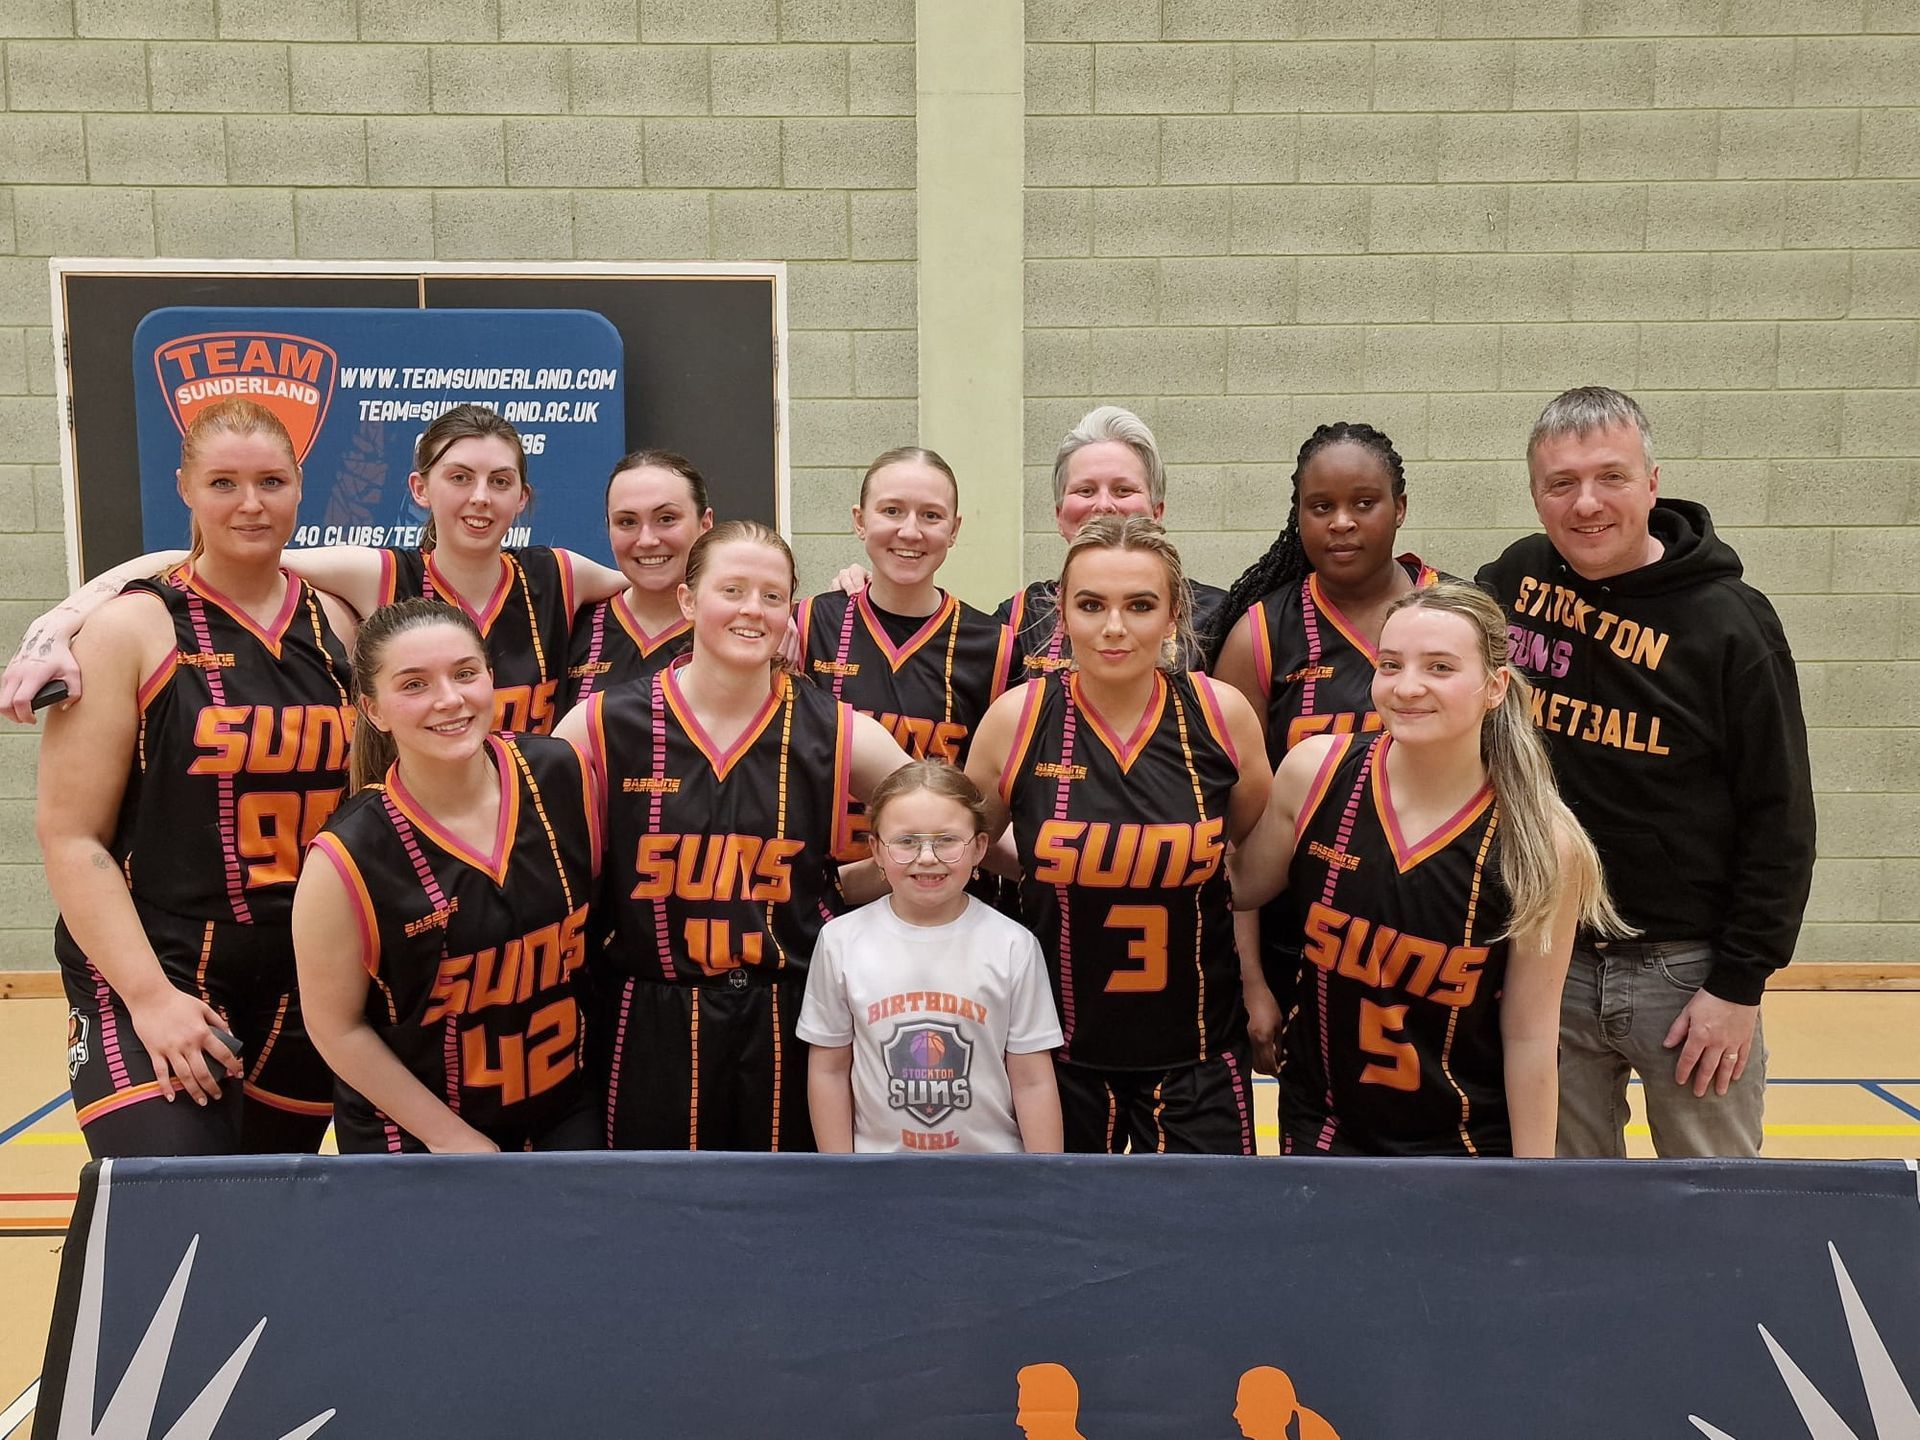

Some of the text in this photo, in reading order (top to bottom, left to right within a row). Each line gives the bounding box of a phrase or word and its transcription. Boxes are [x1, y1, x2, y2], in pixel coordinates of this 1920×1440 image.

[164, 340, 324, 383] TEAM
[340, 367, 617, 391] WWW.TEAMSUNDERLAND.COM
[177, 376, 319, 405] SUNDERLAND
[358, 400, 599, 423] TEAM@SULAND.AC.UK
[294, 525, 320, 546] 40
[323, 525, 425, 548] CLUBS/TE
[1527, 687, 1670, 756] KETBALL
[622, 777, 682, 788] BASELINE
[630, 833, 806, 903] SUNS
[1033, 815, 1226, 889] SUNS
[403, 896, 459, 934] BASELE
[420, 902, 590, 1027] SUNS
[1103, 904, 1169, 992] 3
[1303, 901, 1490, 1008] SUNS
[867, 990, 988, 1026] BIRTHDAY
[461, 996, 577, 1107] 42
[1358, 997, 1421, 1092] 5
[901, 1067, 955, 1080] STOCKTON
[889, 1077, 970, 1110] SUNS
[901, 1128, 960, 1151] GIRL
